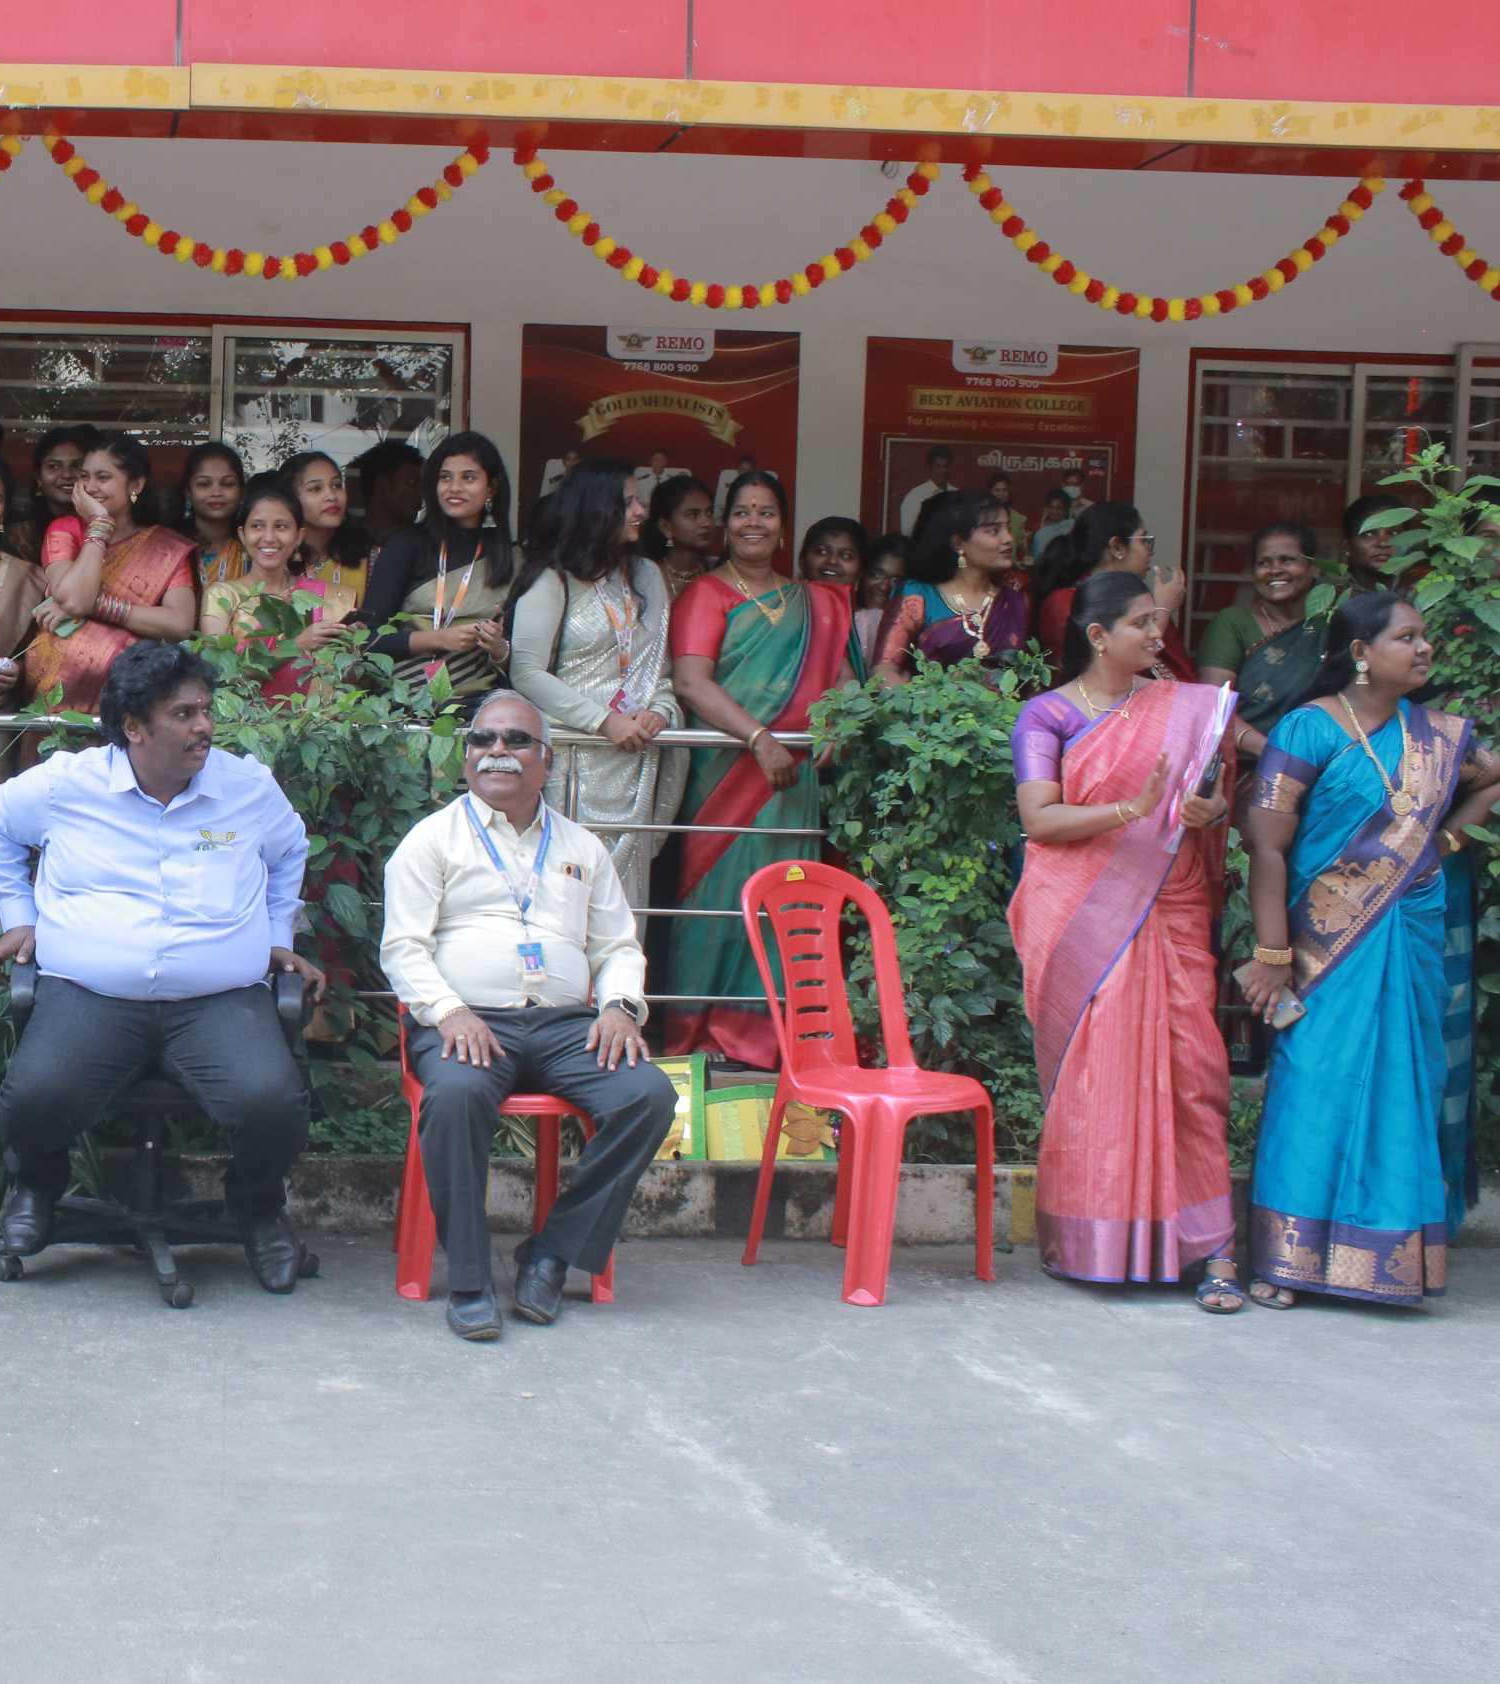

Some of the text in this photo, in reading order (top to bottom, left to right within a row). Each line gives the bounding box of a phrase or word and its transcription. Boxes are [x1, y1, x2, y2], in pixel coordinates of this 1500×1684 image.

[656, 336, 705, 350] REMO
[1000, 349, 1048, 364] REMO
[623, 362, 699, 373] 7768 800 900
[594, 395, 725, 419] GOLD MEDALISTS
[919, 393, 1085, 413] BEST AVIATION COLLEGE
[980, 418, 1035, 431] Acemic
[1036, 420, 1099, 432] Excellenc
[977, 448, 1084, 472] விருதுகள்
